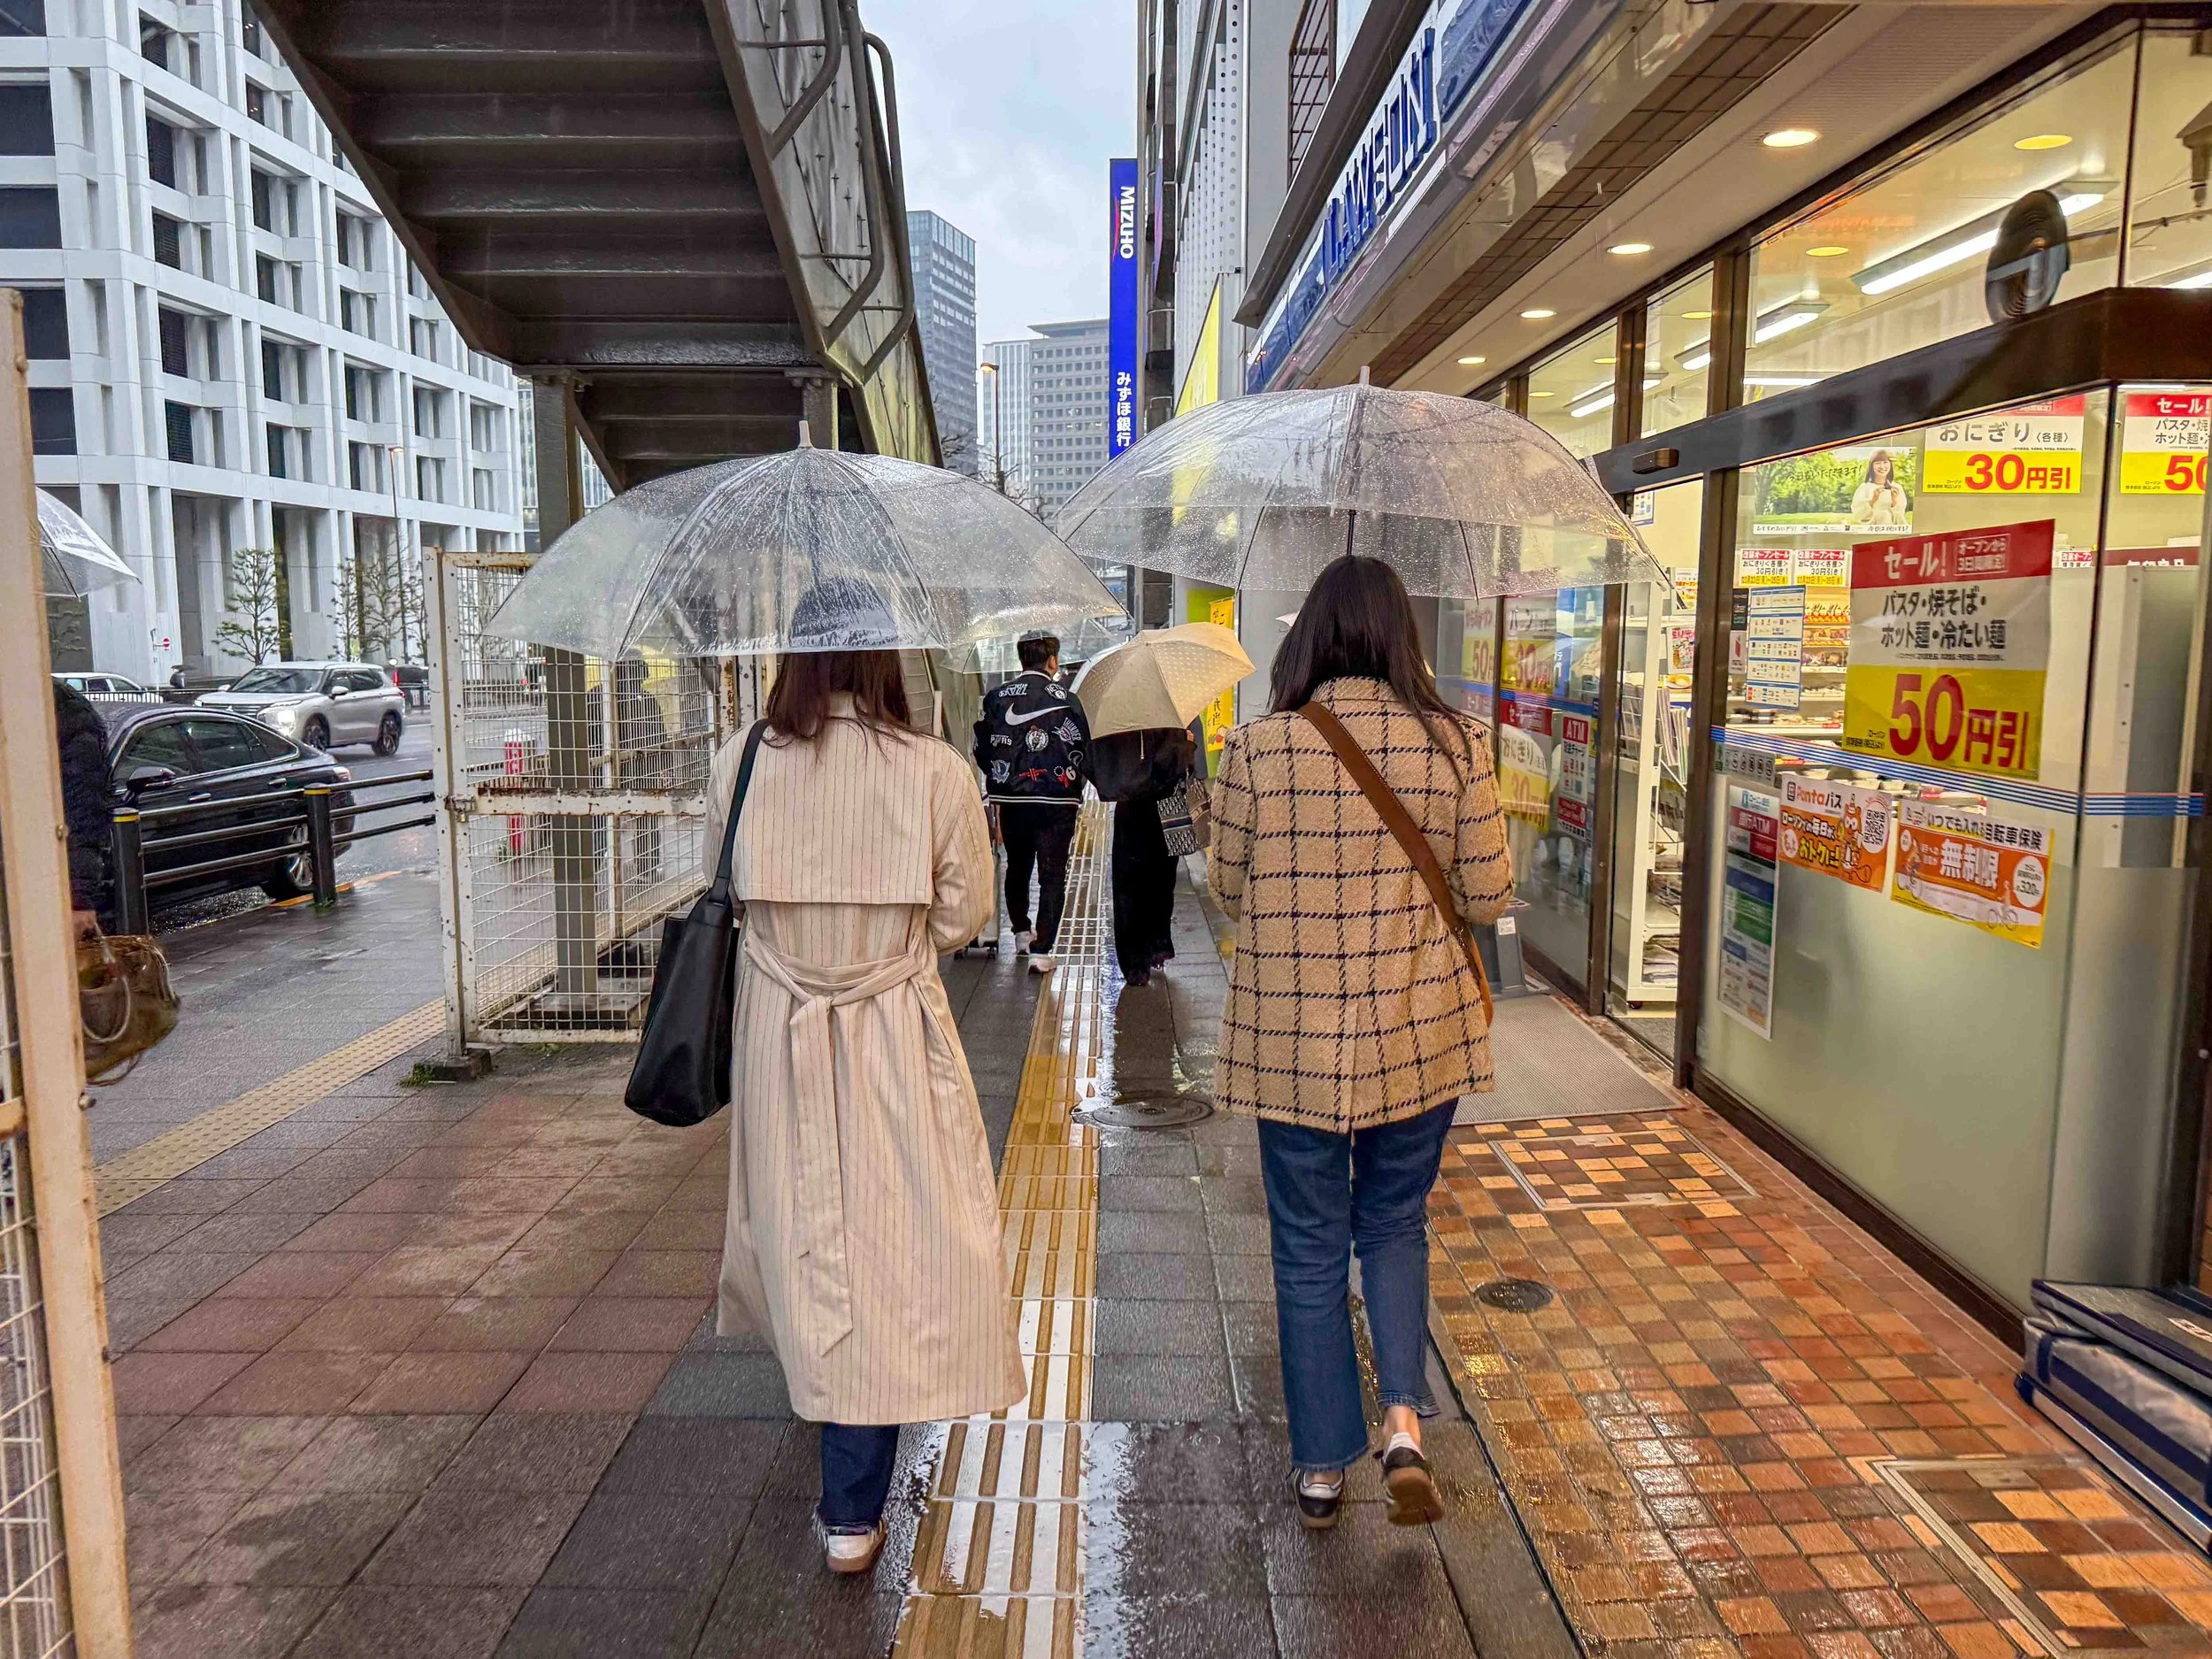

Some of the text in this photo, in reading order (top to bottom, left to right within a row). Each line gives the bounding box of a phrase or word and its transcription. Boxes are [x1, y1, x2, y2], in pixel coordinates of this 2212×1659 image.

[1119, 186, 1135, 259] MIZUHO
[1116, 371, 1133, 447] みずほ銀行
[1939, 420, 2032, 442] おにぎり
[1963, 453, 2071, 491] 30円引
[1884, 541, 1947, 580] セール!
[1881, 619, 2007, 649] ホット麺・冷たい麺
[1567, 718, 1585, 741] ATM
[1889, 673, 2029, 770] 50円引
